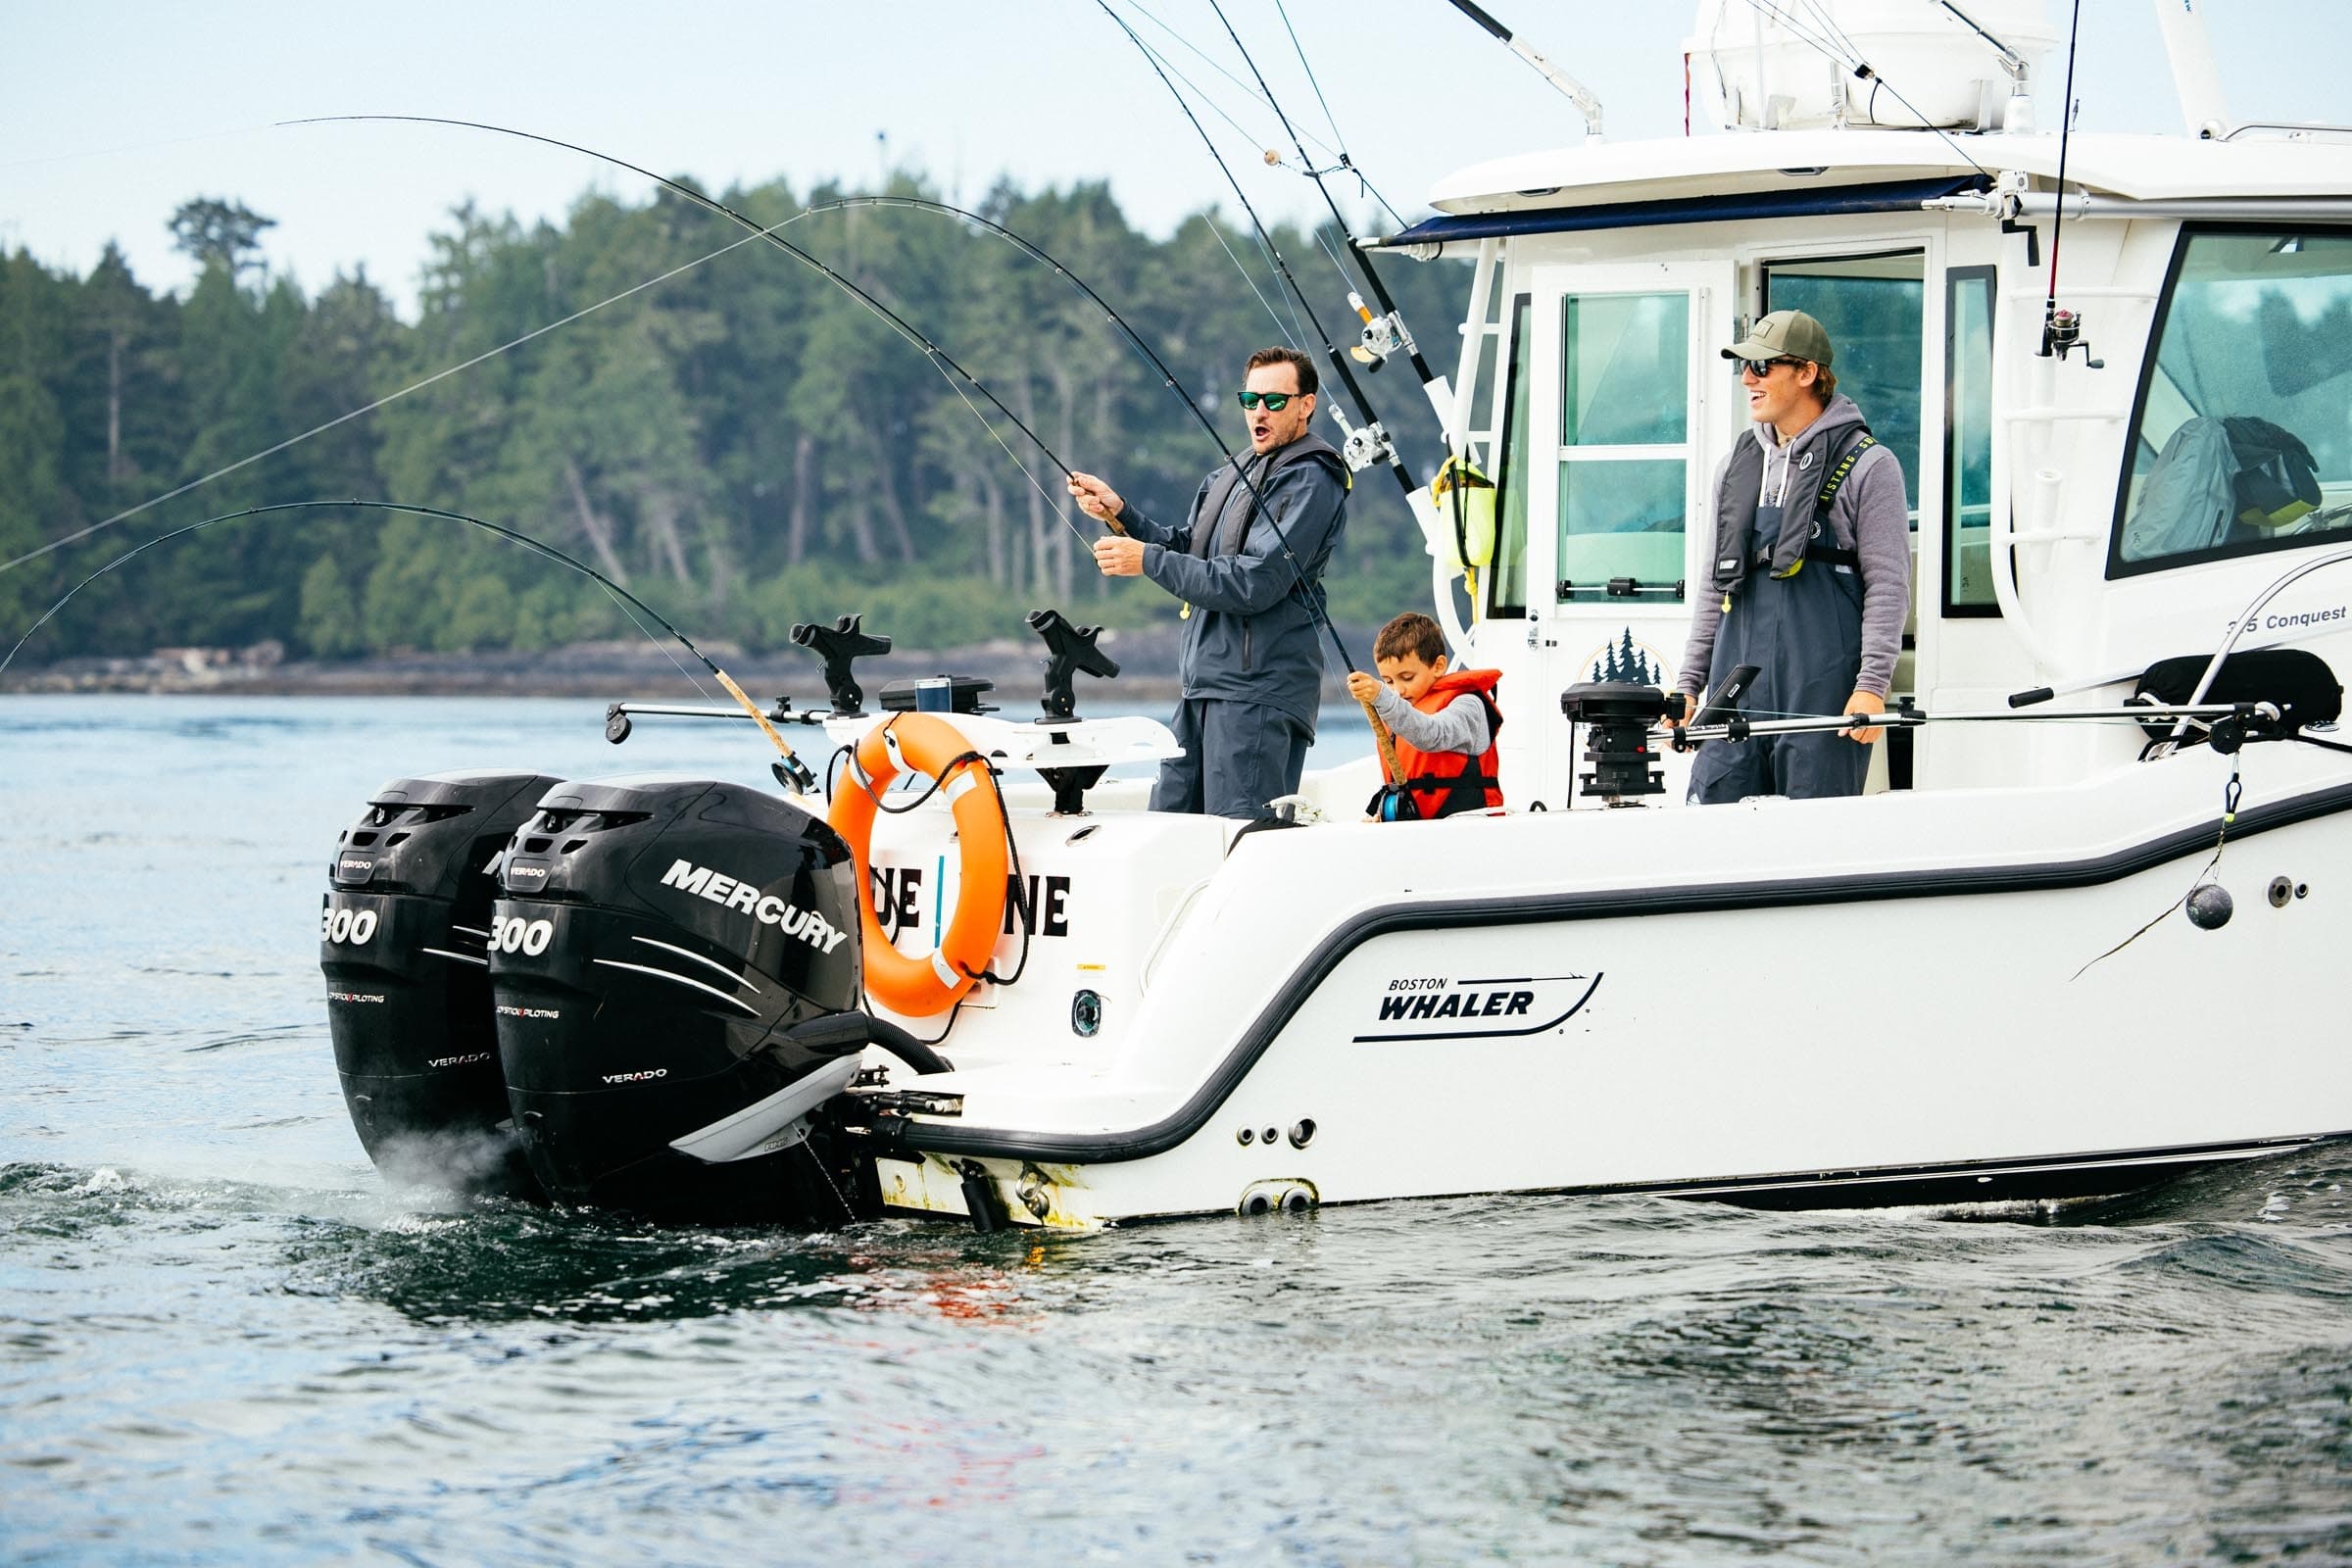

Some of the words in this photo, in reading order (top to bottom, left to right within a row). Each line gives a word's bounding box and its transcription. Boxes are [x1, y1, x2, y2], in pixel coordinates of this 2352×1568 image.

[1820, 455, 1855, 501] STANG
[2227, 617, 2258, 635] 35
[2267, 606, 2346, 629] Conquest
[340, 859, 371, 870] VERADO
[510, 867, 546, 877] VERADO
[660, 858, 848, 955] MERCURY
[1004, 874, 1070, 937] NE
[321, 907, 377, 945] 300
[487, 915, 553, 956] 300
[1388, 978, 1447, 991] BOSTON
[523, 1008, 559, 1018] PILOTING
[1378, 991, 1534, 1020] WHALER
[428, 1052, 490, 1067] VERADO
[603, 1068, 667, 1084] VERADO
